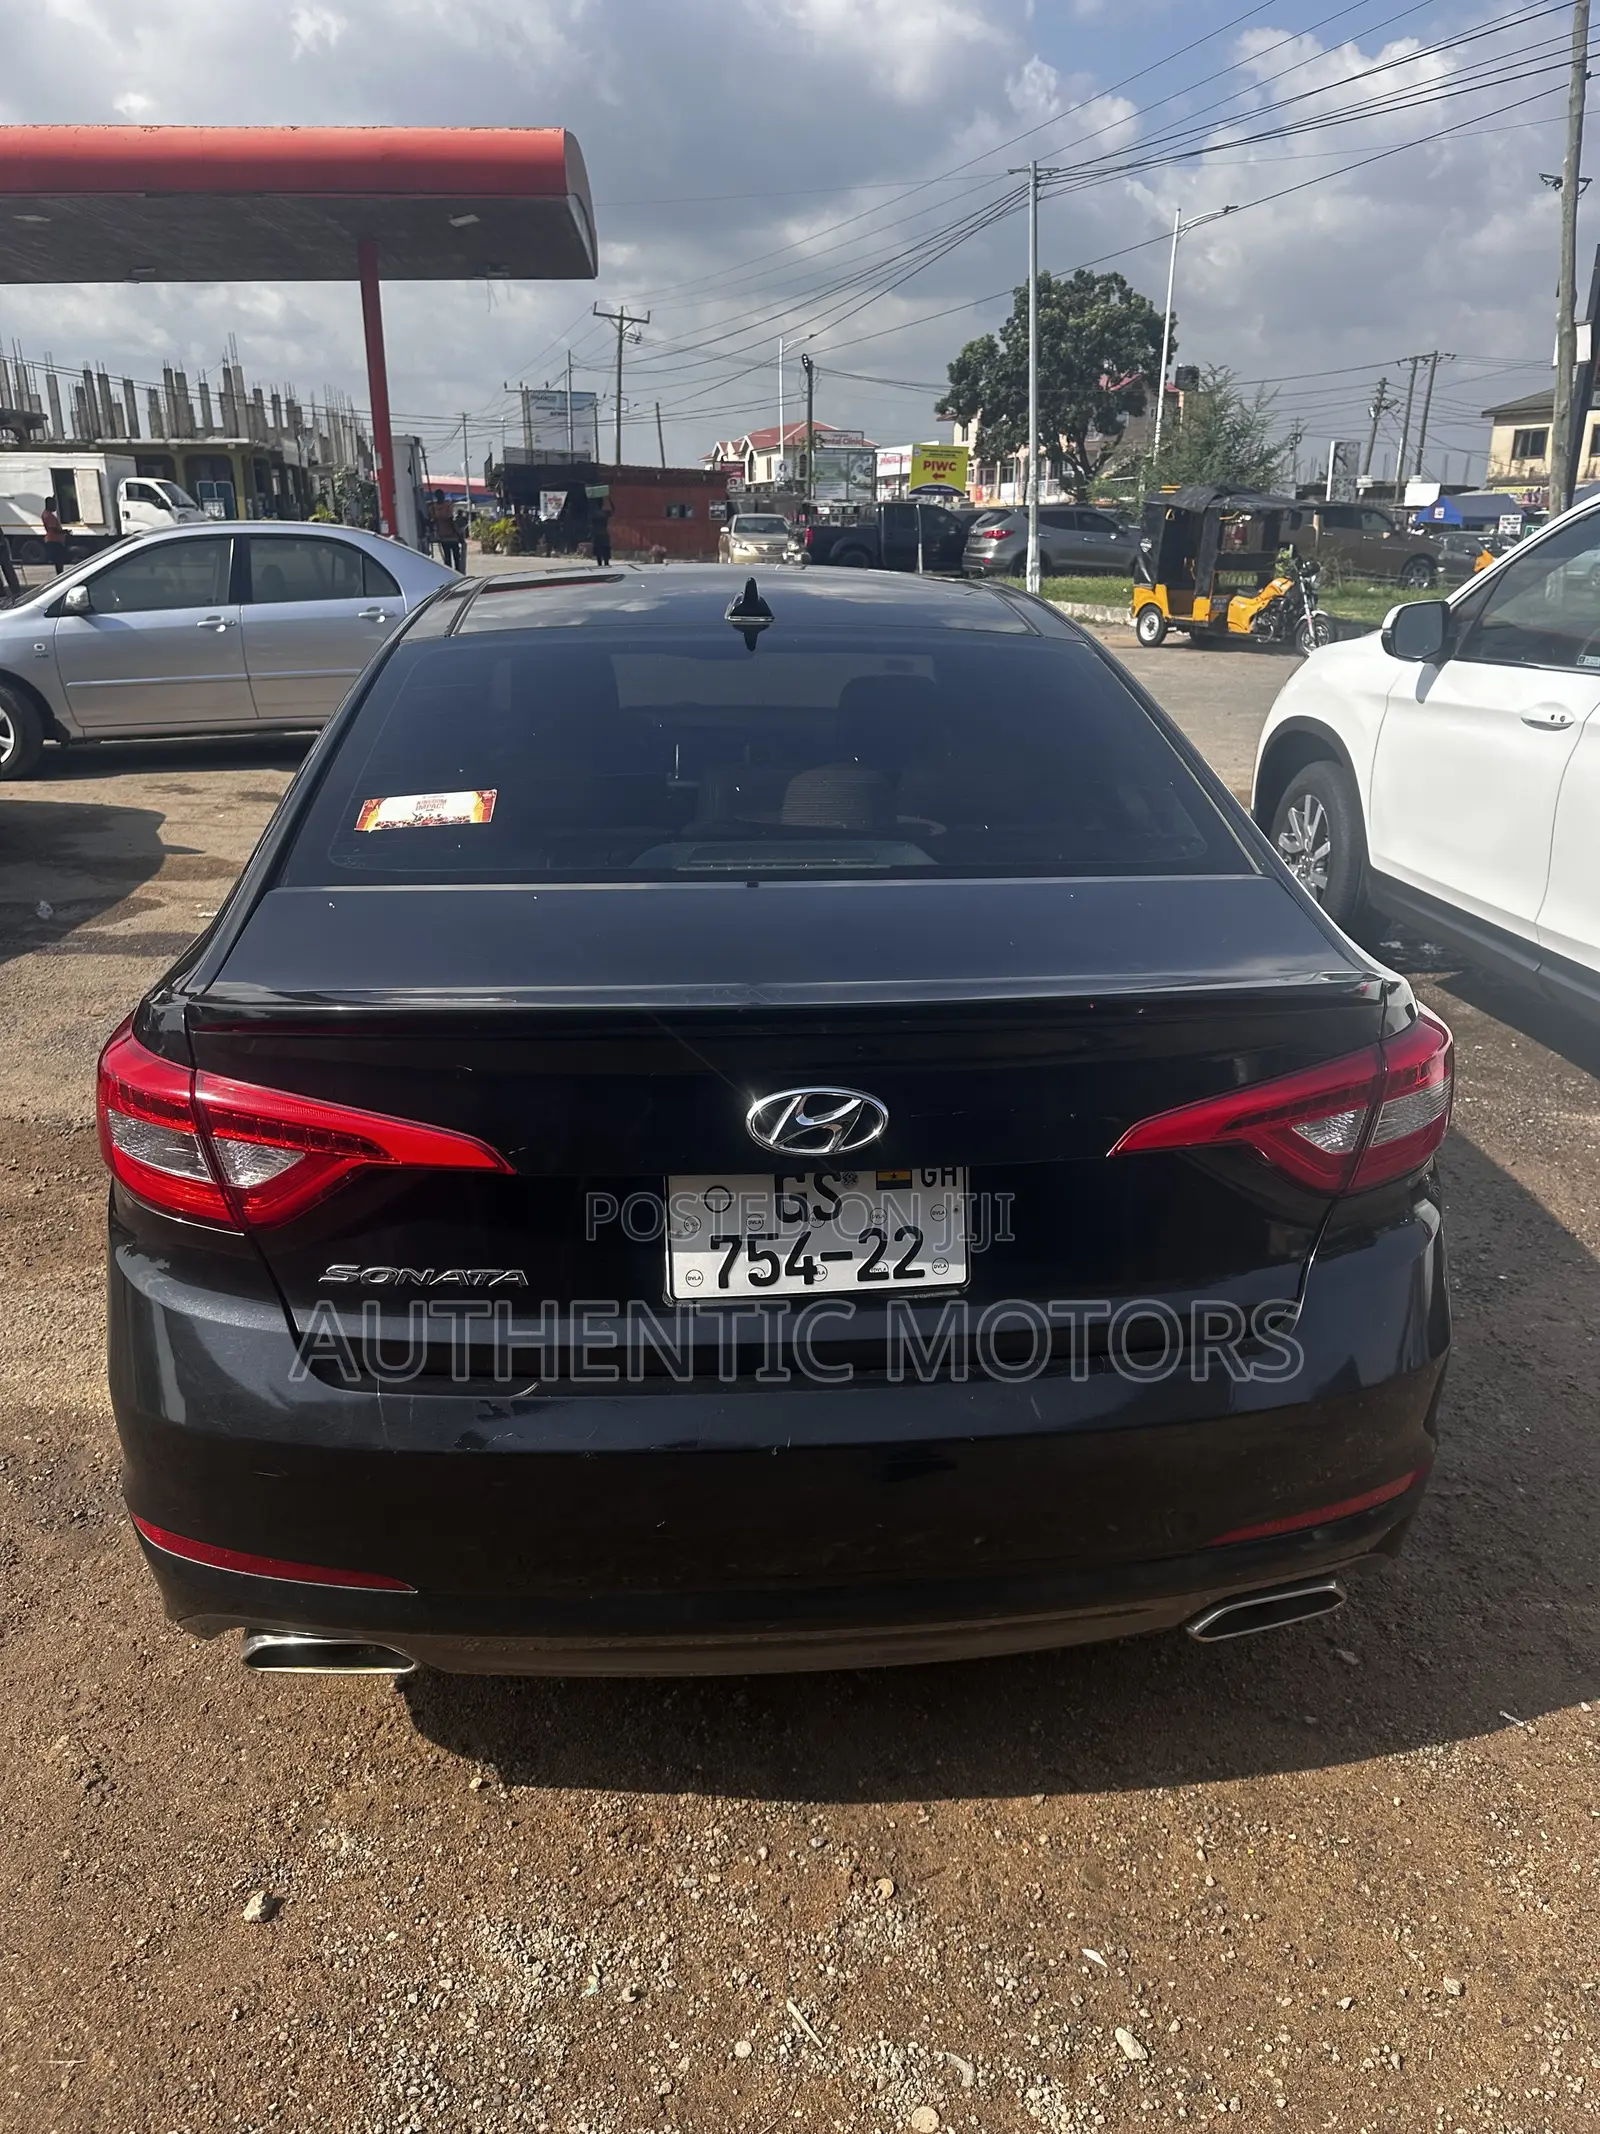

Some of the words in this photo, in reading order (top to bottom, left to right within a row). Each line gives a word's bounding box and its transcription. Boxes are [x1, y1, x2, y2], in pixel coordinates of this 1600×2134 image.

[923, 460, 957, 472] PIWC
[921, 1168, 957, 1187] GH
[775, 1173, 843, 1223] GS
[709, 1225, 926, 1289] 754-22
[318, 1264, 529, 1287] SONATA
